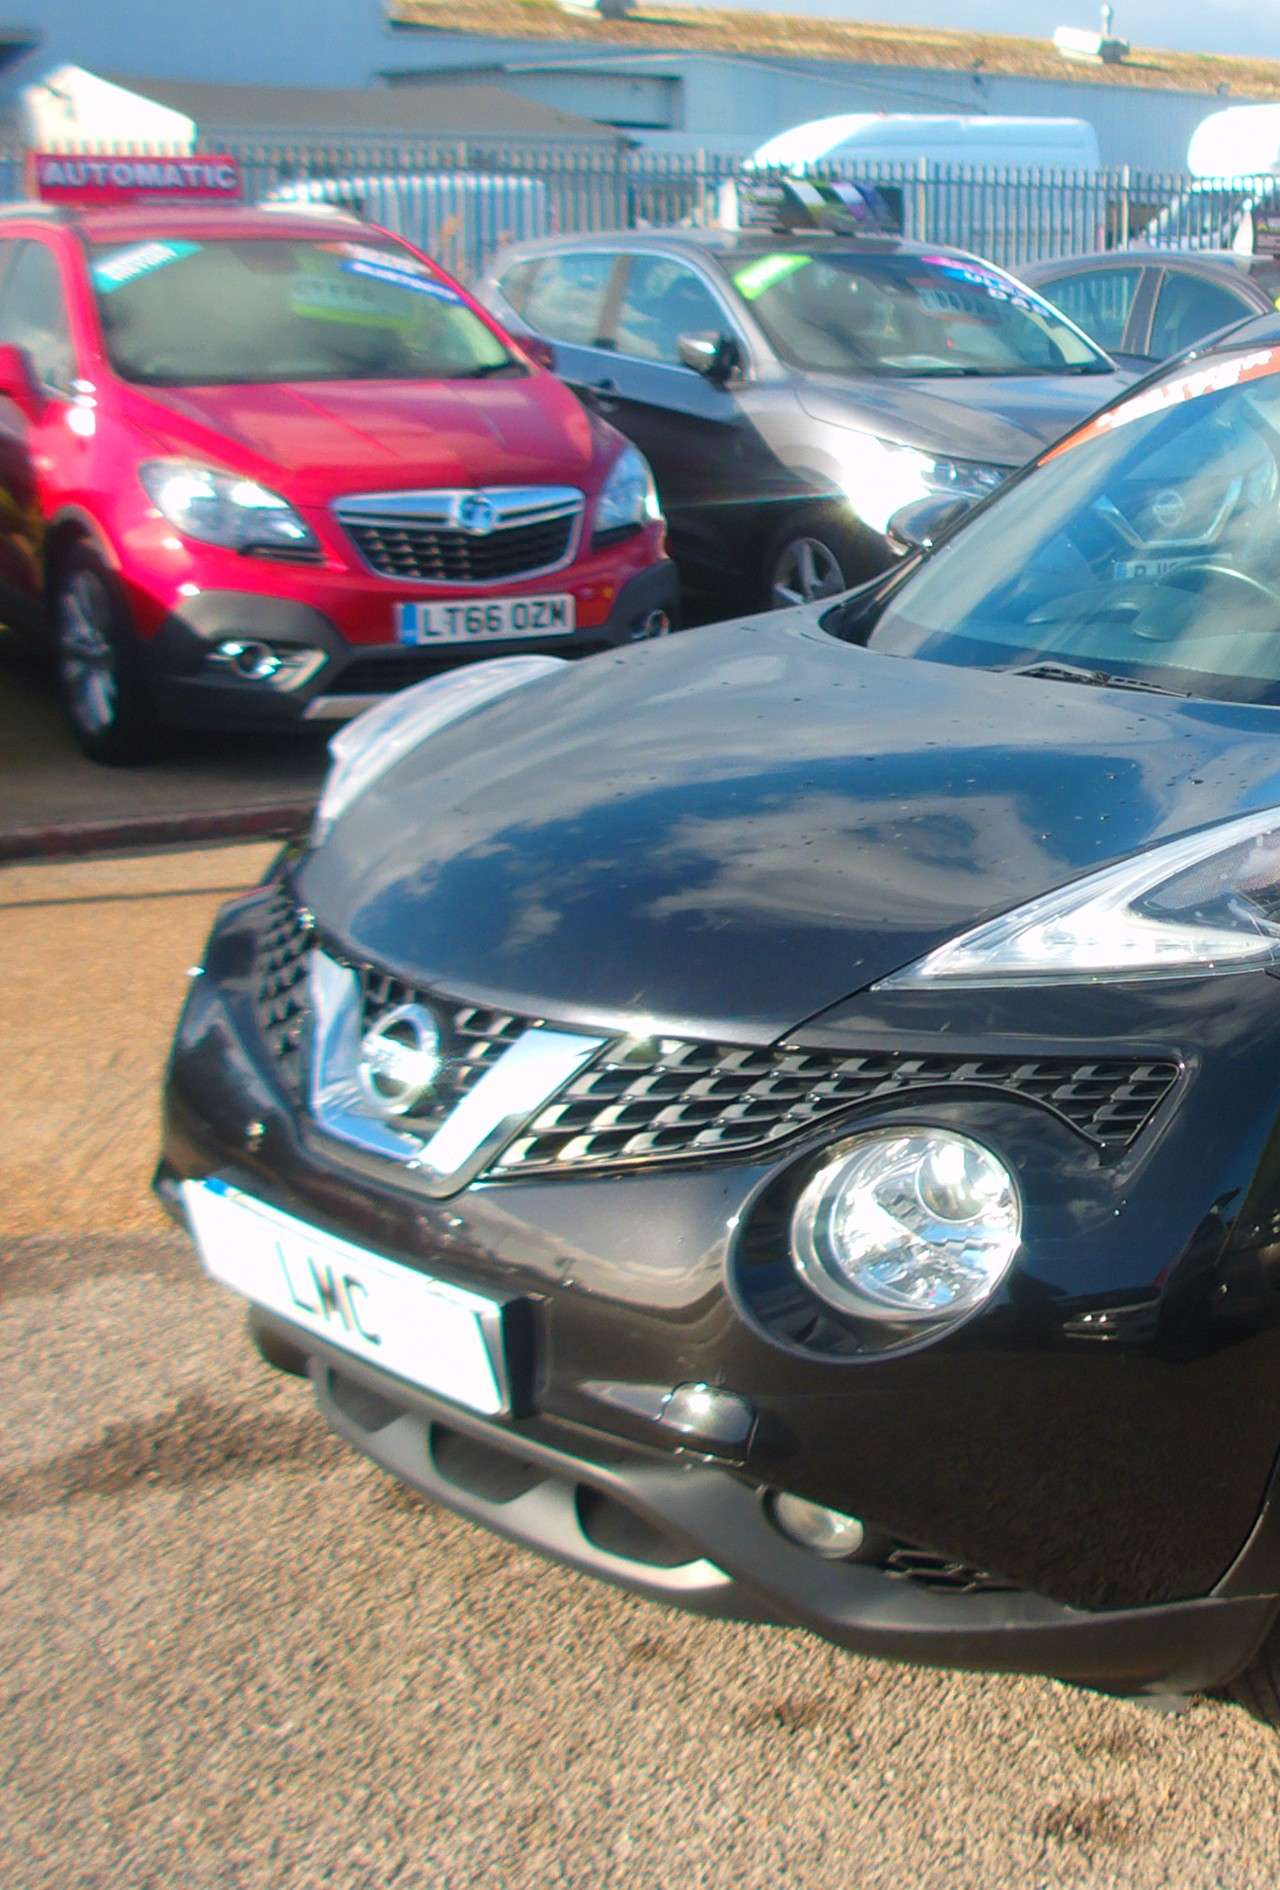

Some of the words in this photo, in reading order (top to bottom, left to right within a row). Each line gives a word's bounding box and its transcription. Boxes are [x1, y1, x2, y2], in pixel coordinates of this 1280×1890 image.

[45, 160, 238, 190] AUTOMATIC
[422, 605, 503, 637] LT66
[274, 1239, 383, 1348] LMC
